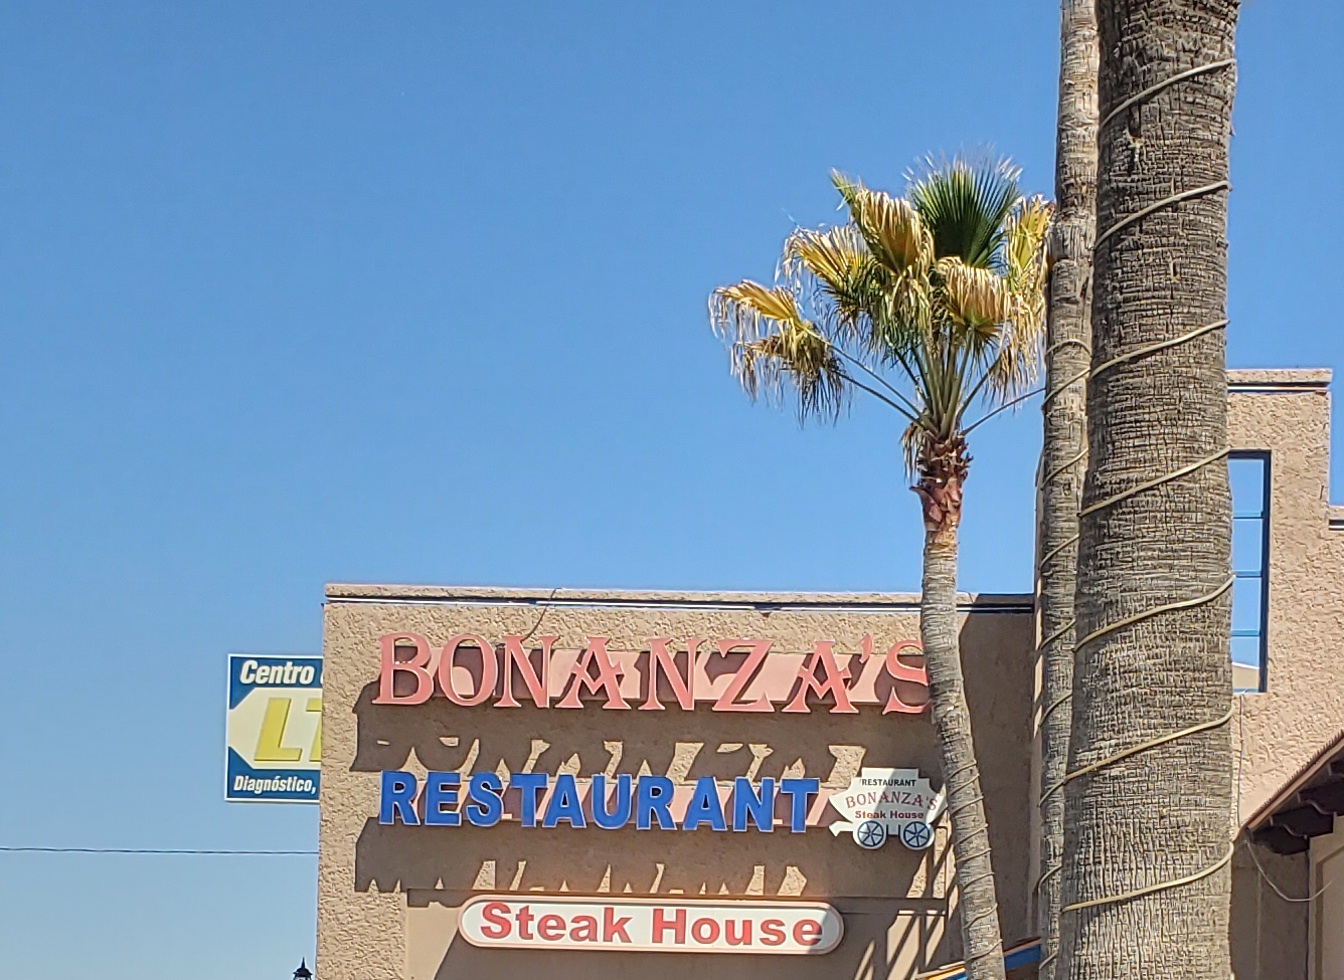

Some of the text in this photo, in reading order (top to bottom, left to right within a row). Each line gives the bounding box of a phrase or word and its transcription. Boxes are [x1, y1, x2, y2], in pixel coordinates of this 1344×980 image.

[239, 660, 315, 685] Centro
[372, 632, 932, 715] BONANZA'S
[234, 775, 316, 794] Diagnóstico,
[861, 778, 917, 787] RESTAURANT
[379, 770, 822, 833] RESTAURANT
[845, 791, 938, 810] BONANZA'S
[855, 810, 924, 819] Steak House
[480, 902, 824, 947] Steak House
